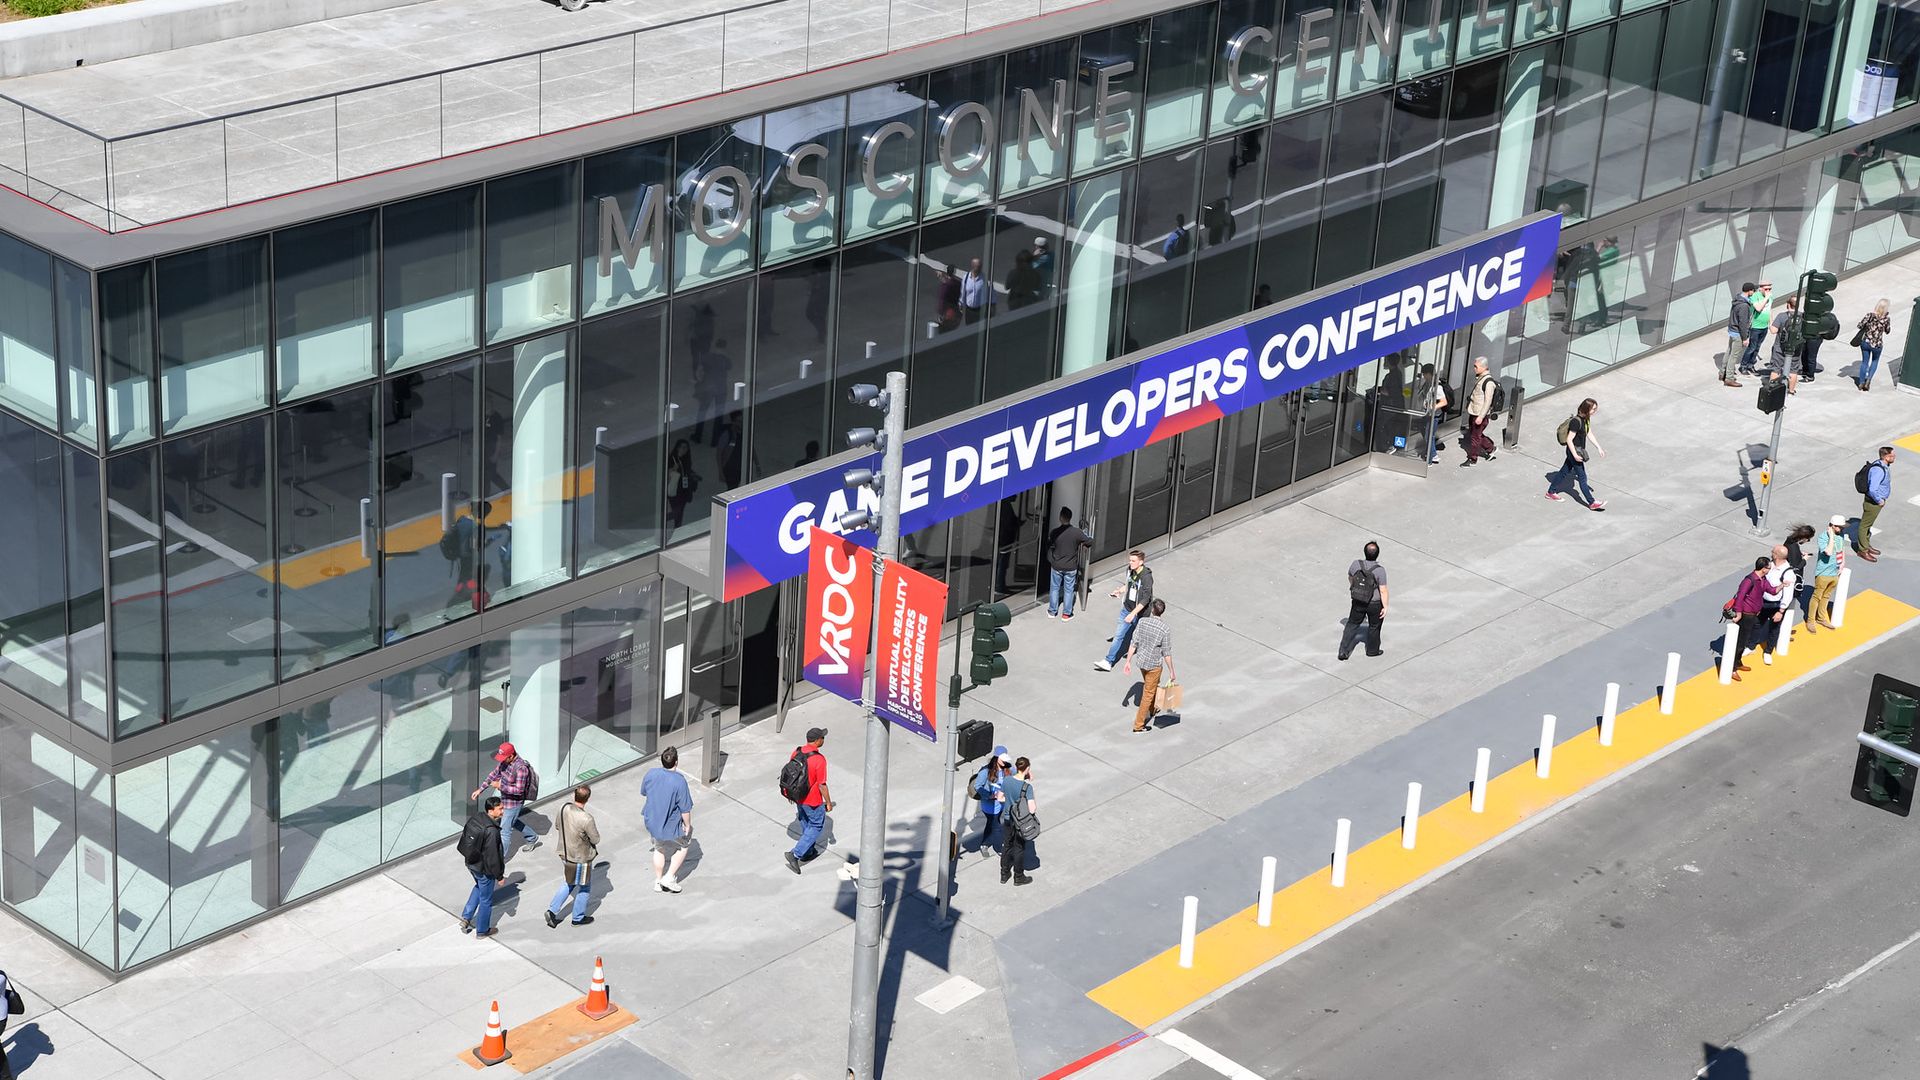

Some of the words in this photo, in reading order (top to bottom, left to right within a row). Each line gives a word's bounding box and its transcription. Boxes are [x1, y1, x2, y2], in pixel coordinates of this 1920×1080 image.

[599, 61, 1135, 277] MOSCONE
[943, 347, 1249, 498] DEVELOPERS
[1258, 246, 1526, 380] CONFERENCE
[605, 648, 629, 663] NORTH
[818, 545, 857, 675] VRDC
[893, 576, 909, 638] REALITY
[900, 607, 916, 706] DEVELOPERS
[888, 640, 902, 699] VIRTUAL
[912, 612, 929, 711] CONFERENCE
